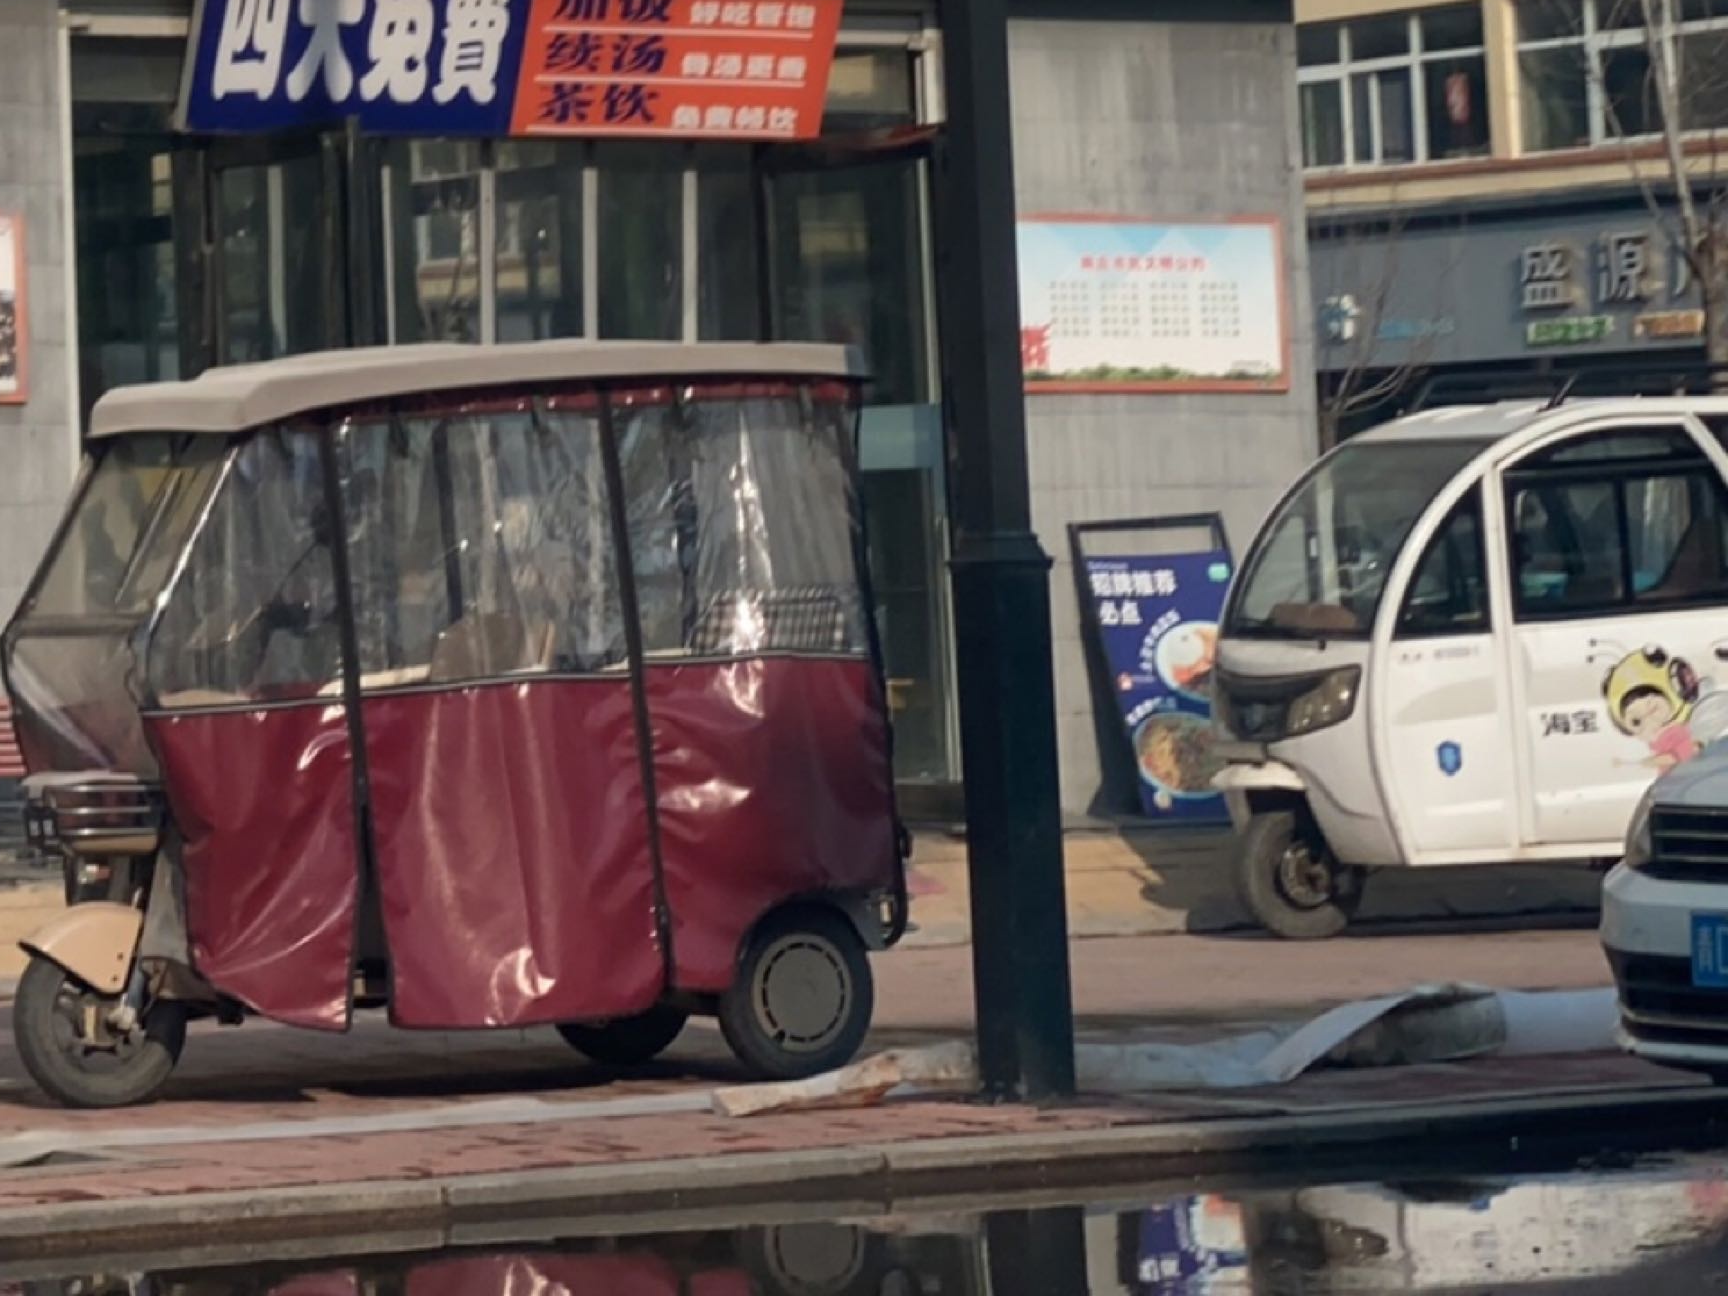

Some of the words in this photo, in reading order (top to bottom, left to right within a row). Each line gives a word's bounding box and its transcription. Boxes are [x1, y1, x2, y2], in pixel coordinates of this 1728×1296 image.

[543, 31, 669, 73] 续汤
[537, 81, 661, 124] 茶饮
[672, 103, 798, 131] 免费畅饮
